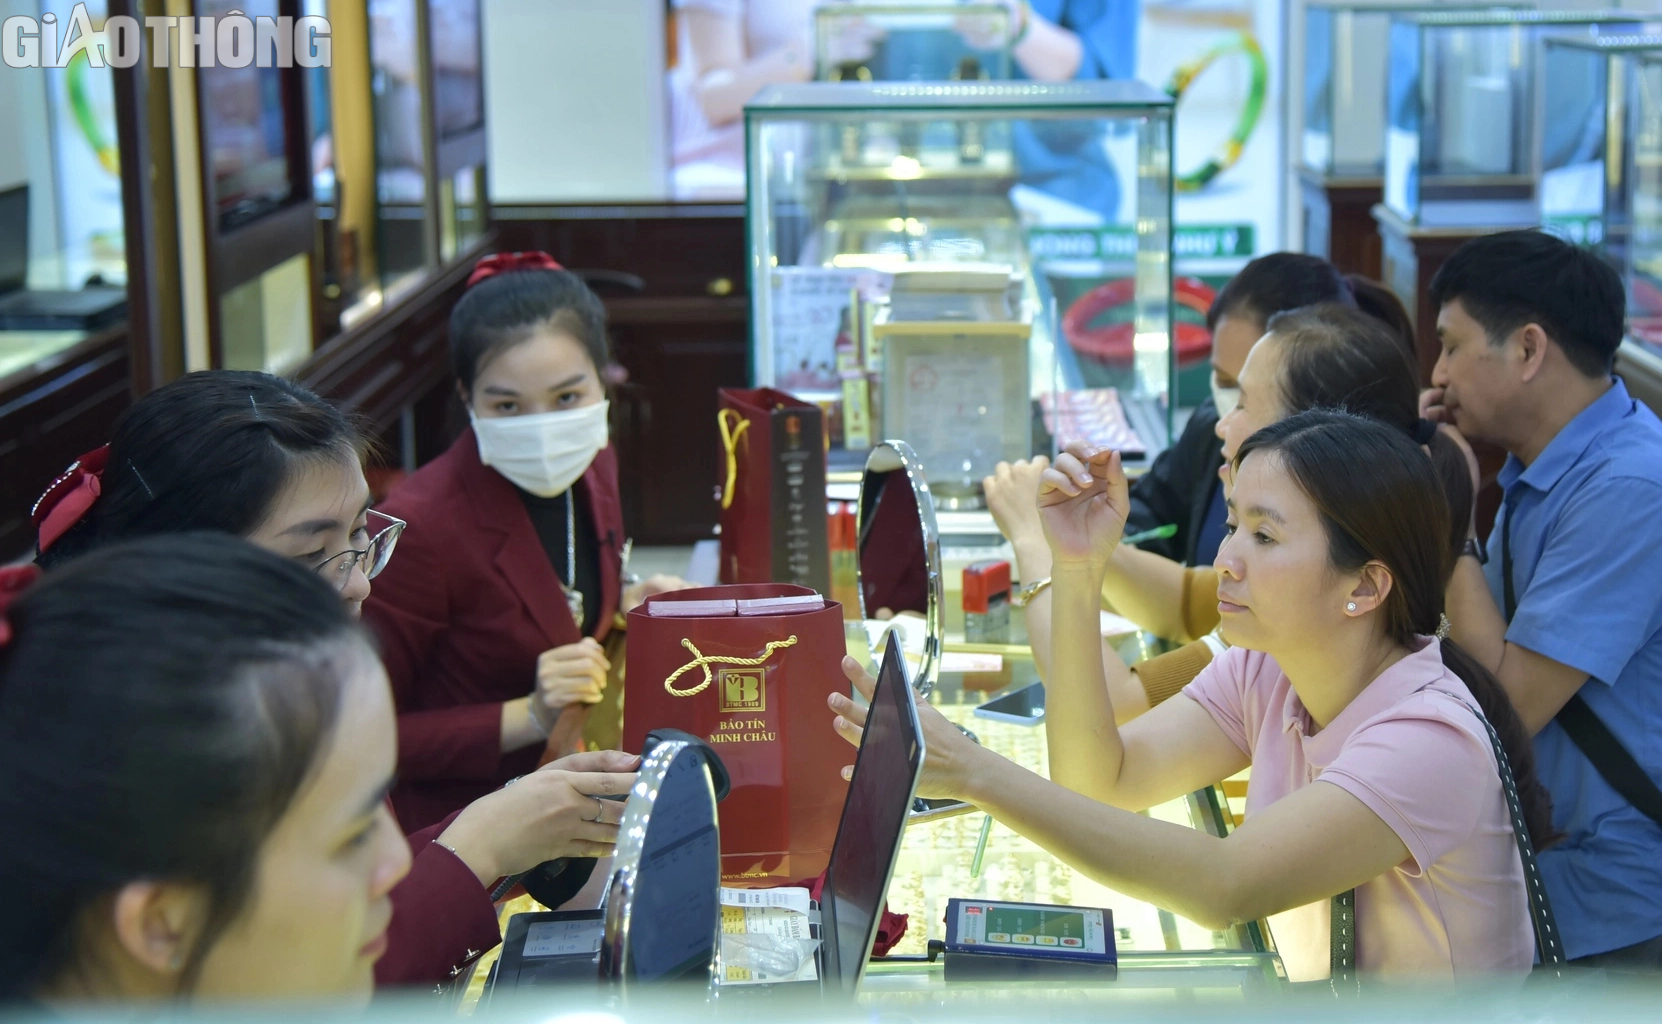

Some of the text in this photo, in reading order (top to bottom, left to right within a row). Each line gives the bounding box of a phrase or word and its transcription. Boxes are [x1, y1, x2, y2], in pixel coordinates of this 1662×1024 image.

[720, 717, 766, 730] BẢO TÍN
[710, 730, 776, 743] MINH CHÂU
